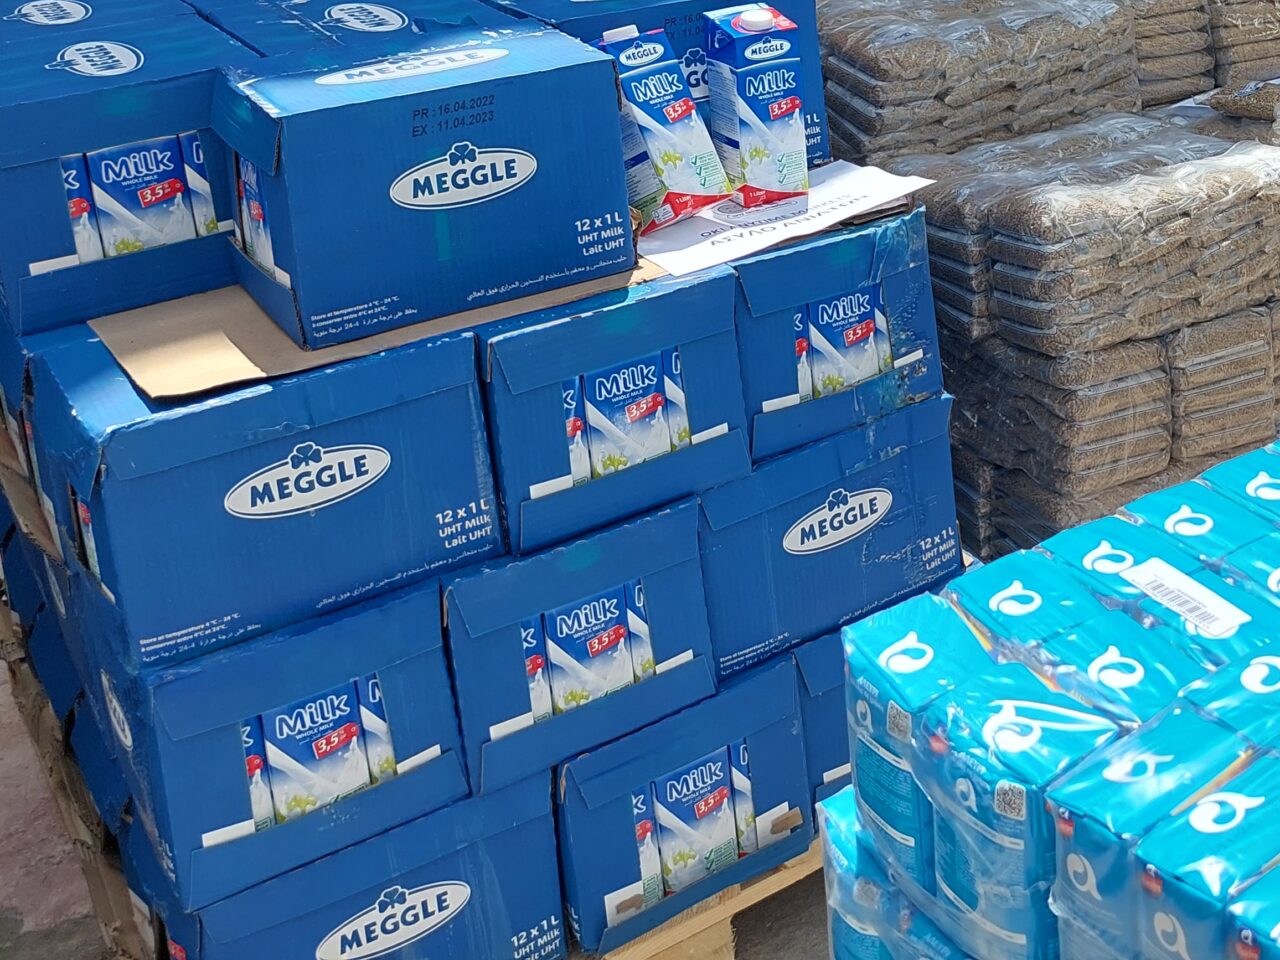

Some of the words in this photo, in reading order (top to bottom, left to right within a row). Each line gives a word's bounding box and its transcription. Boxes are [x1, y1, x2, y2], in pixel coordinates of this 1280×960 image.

[625, 46, 659, 62] MEGGLE
[751, 43, 784, 56] MEGGLE
[344, 51, 482, 80] MEGGLE
[631, 72, 683, 102] Milk
[746, 69, 796, 97] Milk
[101, 149, 175, 184] Milk
[412, 158, 518, 199] MEGGLE
[574, 218, 591, 232] 12
[594, 218, 603, 228] x
[604, 213, 612, 224] 1
[615, 212, 623, 222] L
[577, 231, 599, 244] UHT
[601, 226, 624, 239] Milk
[583, 244, 603, 256] Lait
[604, 238, 625, 251] UHT
[710, 226, 777, 246] ΑΣΥΛΟ
[819, 293, 871, 324] Milk
[595, 365, 657, 400] Milk
[611, 392, 631, 402] WHOLE
[630, 389, 643, 398] MILK
[250, 454, 369, 508] MEGGLE
[435, 510, 453, 525] 12
[457, 507, 467, 518] x
[469, 502, 477, 514] 1
[480, 499, 490, 510] L
[800, 496, 879, 545] MEGGLE
[439, 522, 463, 538] UHT
[465, 514, 492, 529] Milk
[445, 535, 468, 549] Lait
[469, 526, 492, 541] UHT
[919, 537, 932, 551] 12
[933, 534, 941, 545] x
[941, 529, 946, 540] 1
[948, 526, 955, 536] L
[922, 547, 940, 561] UHT
[939, 538, 955, 552] Milk
[926, 558, 941, 570] Lait
[941, 548, 957, 561] UHT
[556, 598, 620, 638] Milk
[275, 694, 350, 739] Milk
[295, 729, 318, 740] WHOLE
[318, 722, 334, 731] MILK
[667, 761, 723, 802] Milk
[339, 890, 450, 955] MEGGLE
[511, 931, 528, 947] 12
[530, 926, 540, 938] x
[541, 919, 548, 930] 1
[551, 915, 559, 926] L
[514, 941, 536, 959] UHT
[537, 928, 560, 947] Milk
[541, 938, 561, 956] UHT
